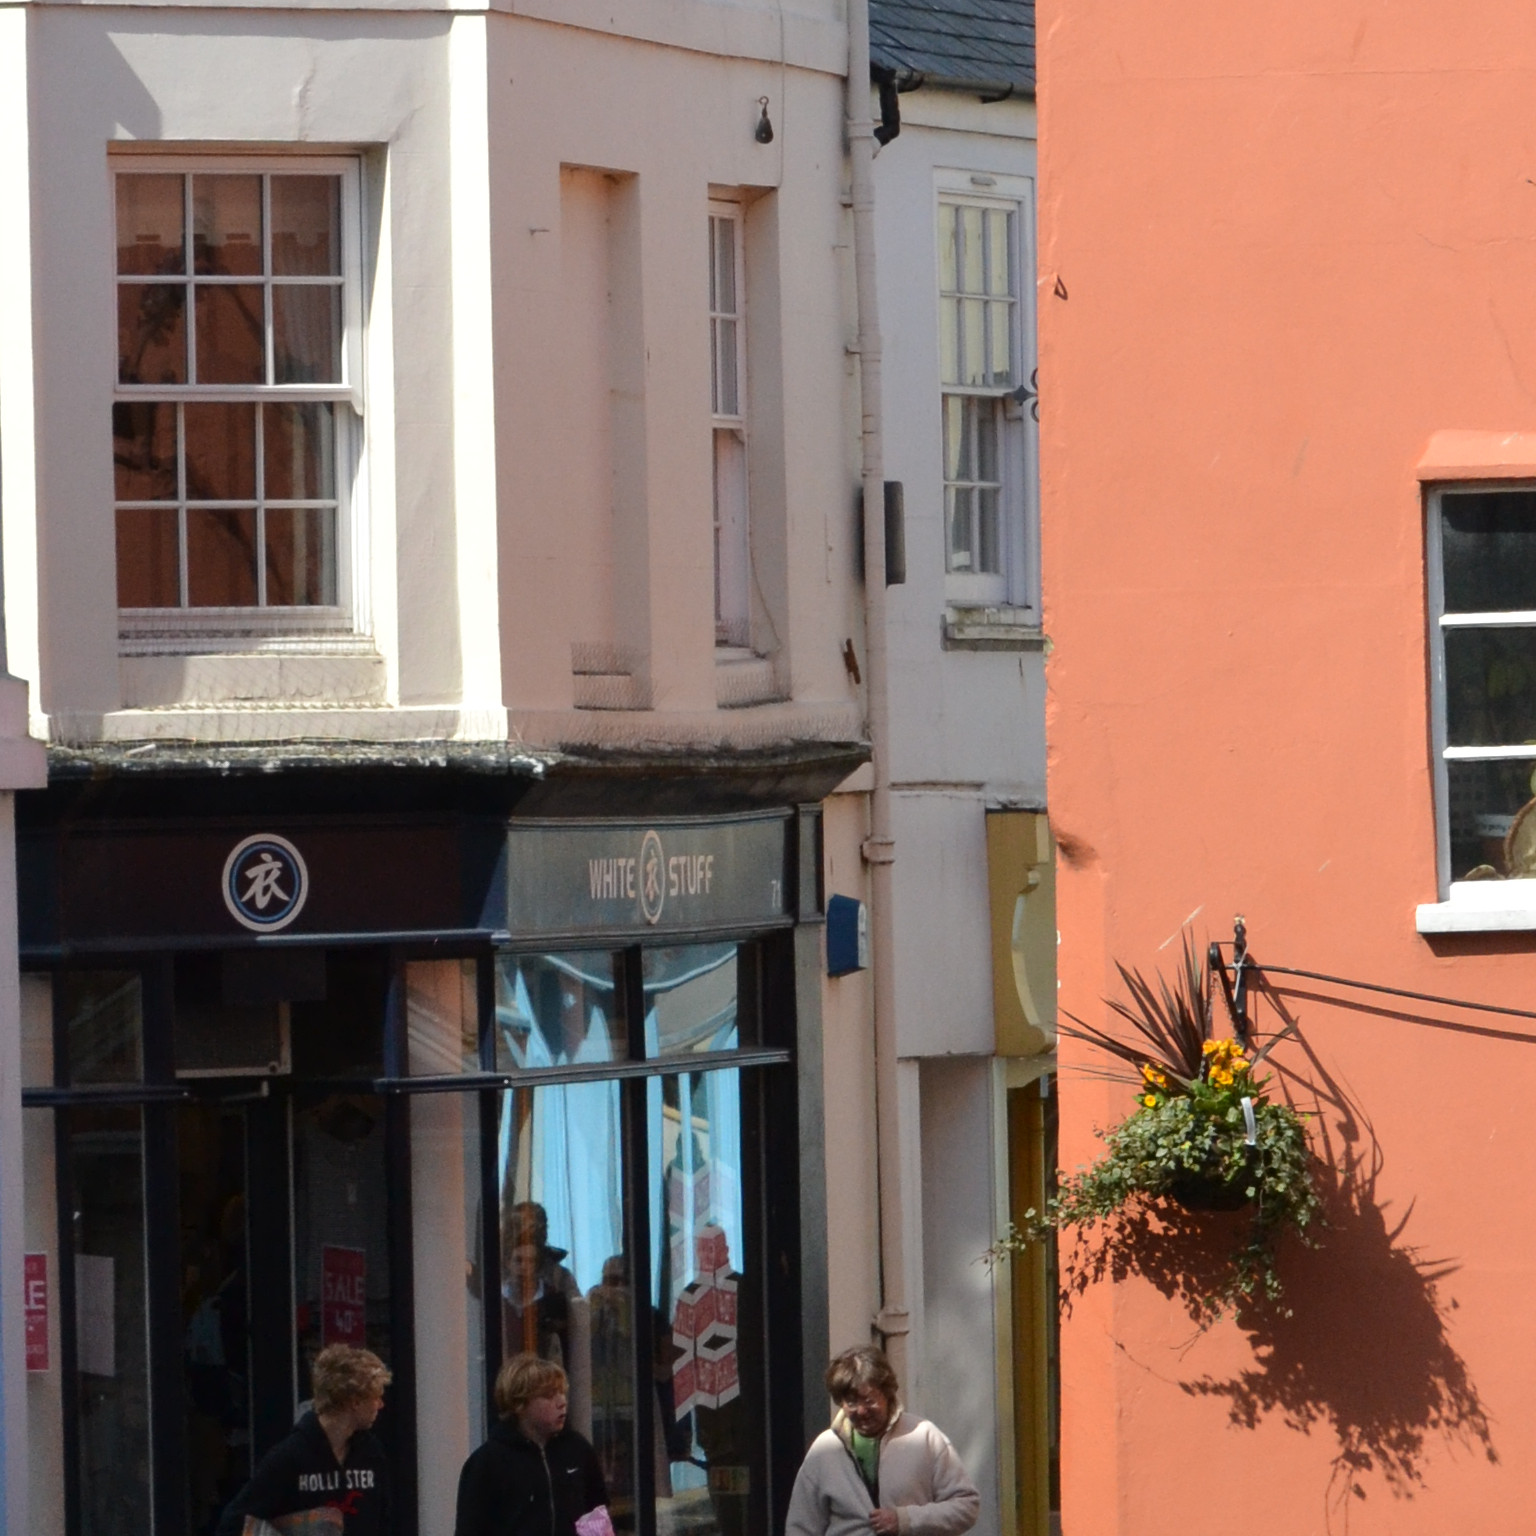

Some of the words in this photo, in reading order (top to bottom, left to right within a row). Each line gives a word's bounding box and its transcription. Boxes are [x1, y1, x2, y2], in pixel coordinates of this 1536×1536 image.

[589, 857, 636, 900] WHITE
[669, 855, 714, 897] STUFF
[324, 1271, 365, 1306] SALE
